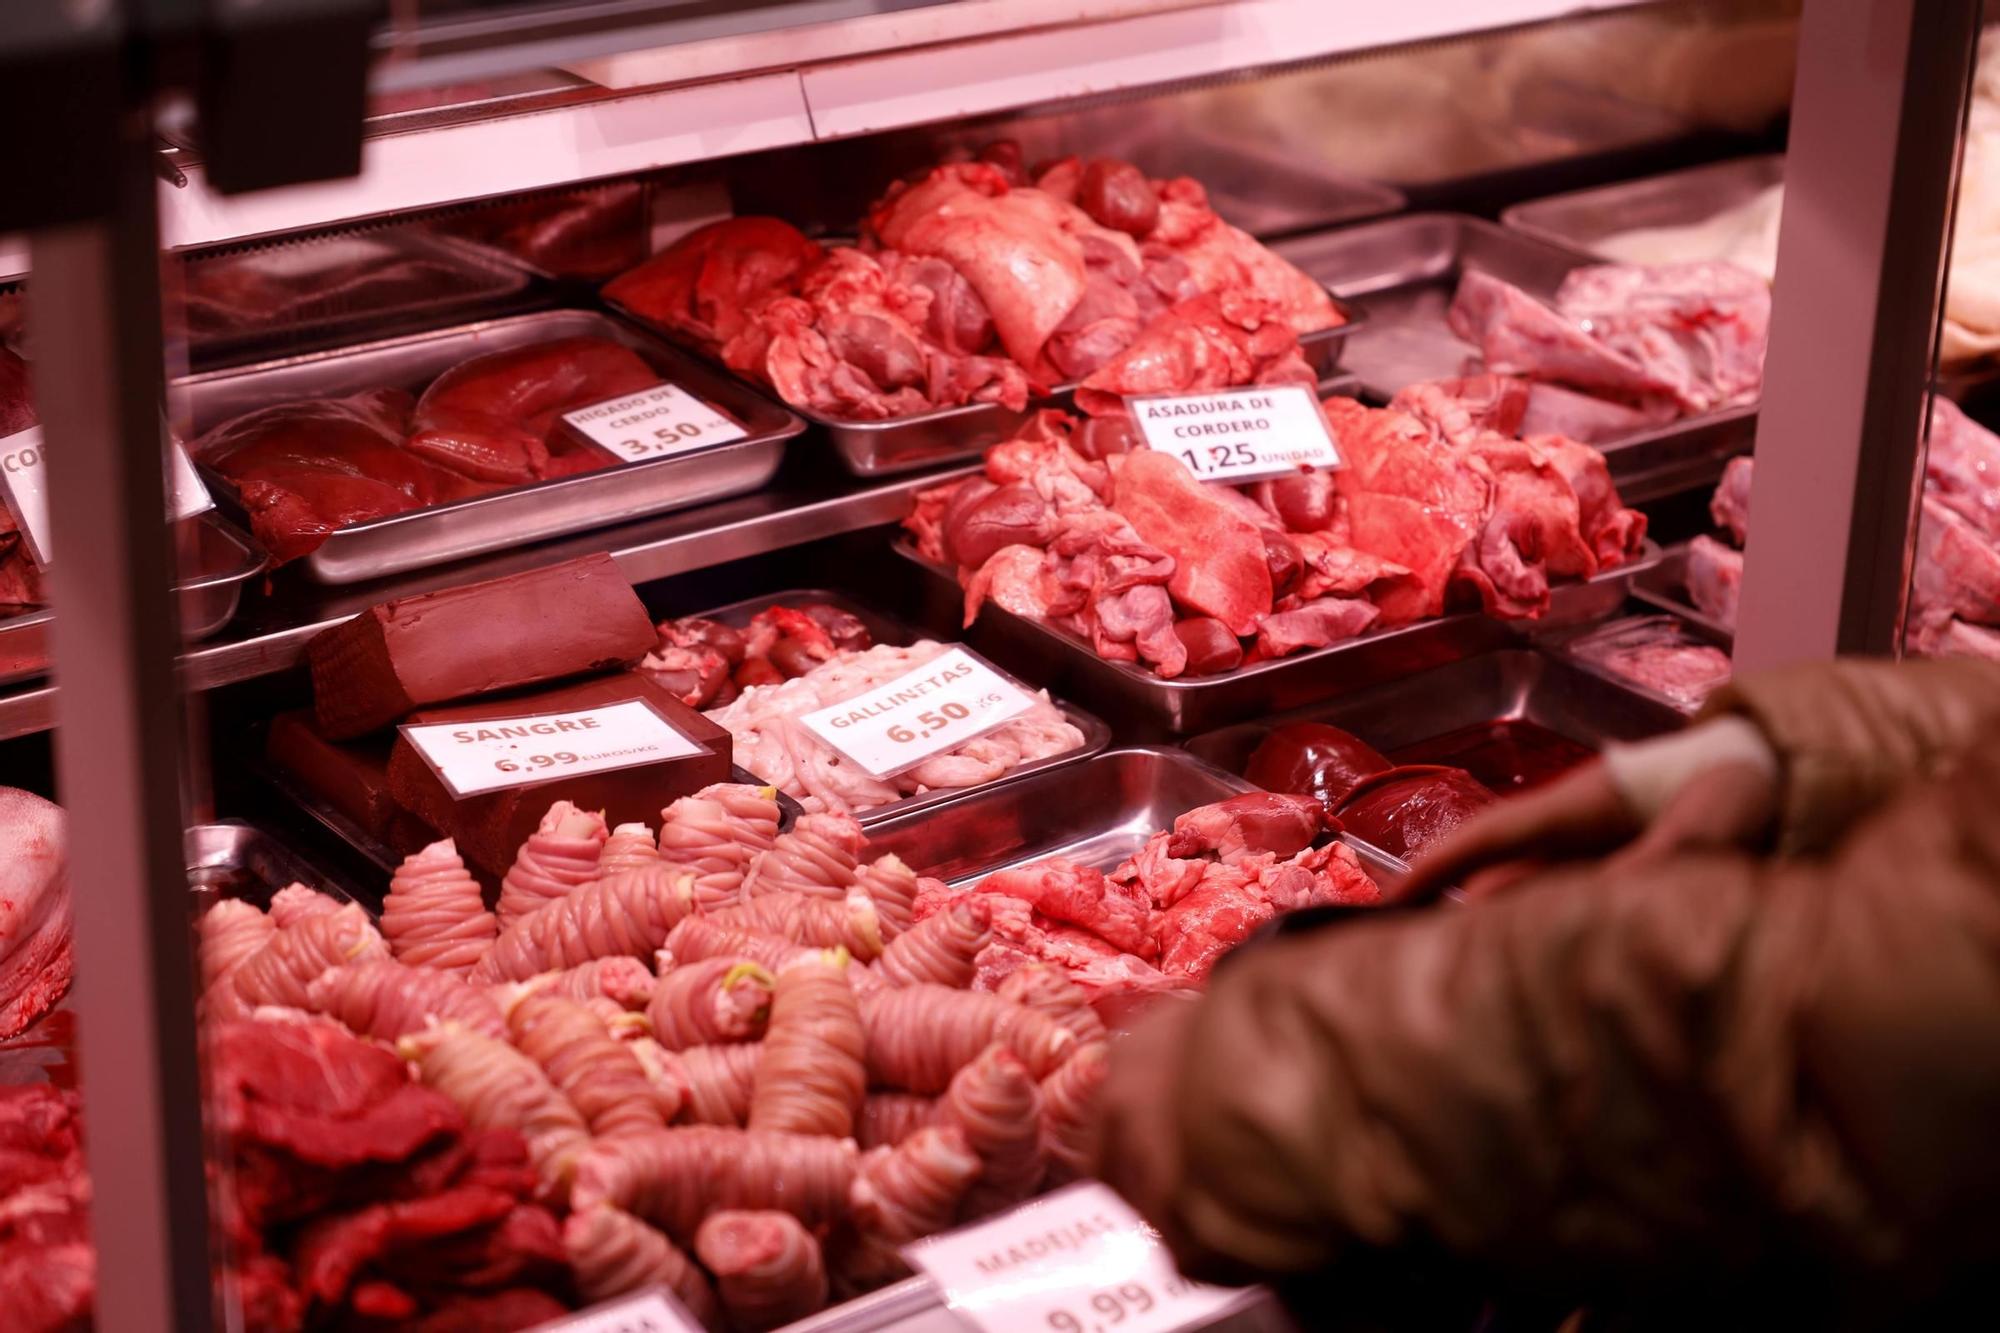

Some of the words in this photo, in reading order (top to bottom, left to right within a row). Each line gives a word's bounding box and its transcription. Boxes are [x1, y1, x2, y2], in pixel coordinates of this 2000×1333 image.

[649, 389, 673, 402] DE
[1148, 399, 1245, 419] ASADURA
[1250, 397, 1275, 409] DE
[609, 406, 670, 429] CERDO
[1174, 418, 1270, 439] CORDERO
[620, 422, 702, 455] 3,50
[1182, 443, 1257, 473] 1,25
[1261, 449, 1325, 463] UNIDAD
[830, 662, 974, 728] GALLINETAS
[452, 717, 603, 744] SANGRE
[887, 702, 970, 743] 6,50
[494, 751, 579, 772] 6,99
[581, 744, 659, 761] EUROS/KG
